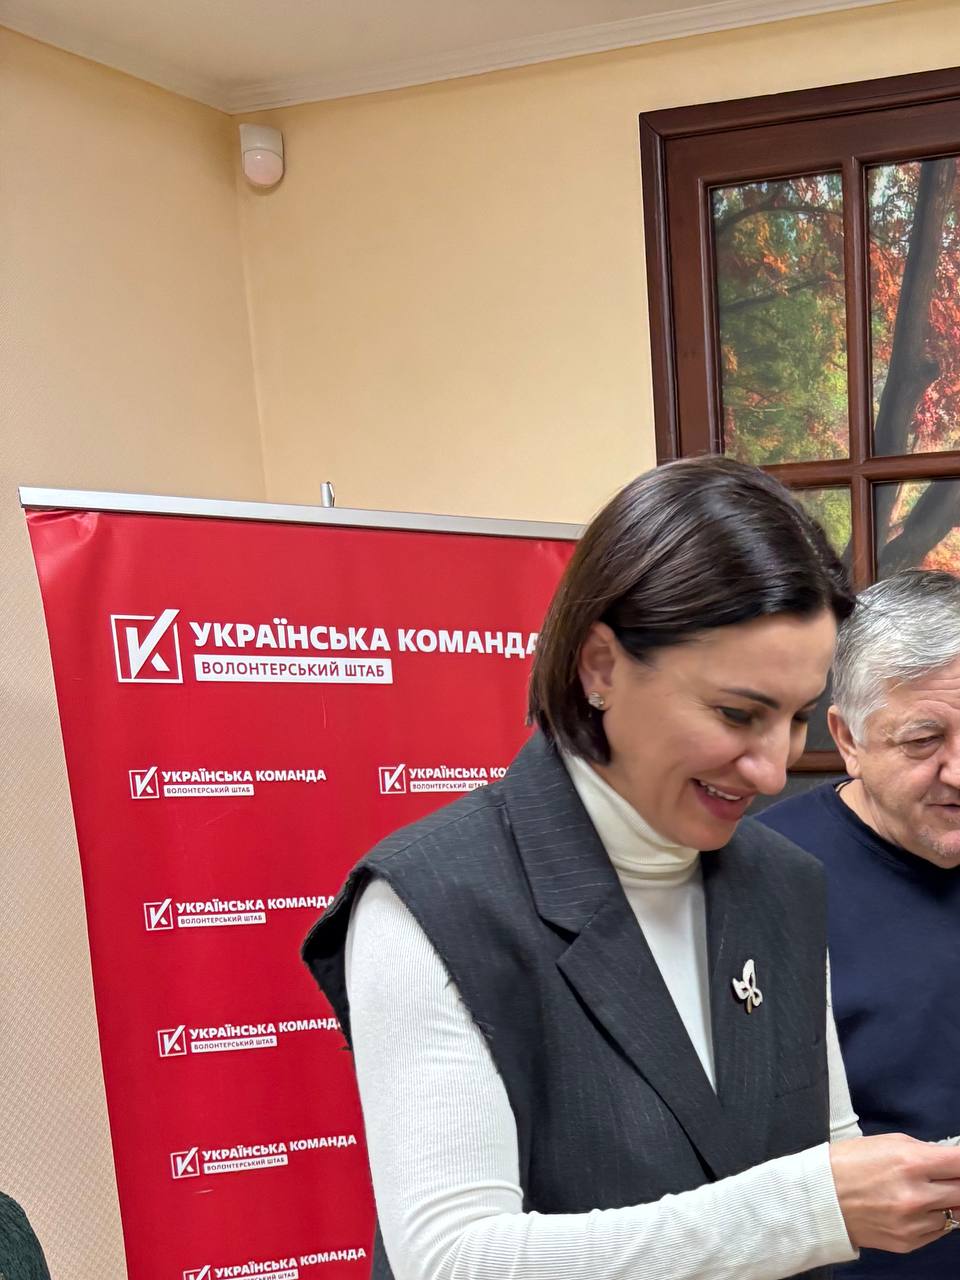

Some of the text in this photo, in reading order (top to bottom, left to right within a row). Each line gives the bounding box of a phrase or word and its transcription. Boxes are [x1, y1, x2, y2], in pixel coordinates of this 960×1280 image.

[189, 617, 391, 652] УКРАЇНСЬКА
[202, 661, 385, 677] ВОЛОНТЕРСЬКИЙ ШТАБ
[162, 768, 326, 783] УКРАЇНСЬКА КОМАНДА
[409, 765, 488, 779] УКРАЇНСЬКА
[166, 786, 229, 794] ВОЛОНТЕРСЬКИЙ
[412, 782, 466, 790] ВОЛОНТЕРСЬКИЙ
[176, 899, 265, 913] УКРАЇНСЬКА
[181, 916, 242, 924] ВОЛОНТЕРСЬКИЙ
[189, 1018, 340, 1040] УКРАЇНСЬКА КОМАНД
[194, 1039, 254, 1050] ВОЛОНТЕРСЬКИЙ
[202, 1134, 357, 1161] УКРАЇНСЬКА КОМАНДА
[207, 1160, 266, 1171] ВОЛОНТЕРСЬКИЙ
[215, 1248, 366, 1278] УКРАЇНСЬКА КОМАНДА
